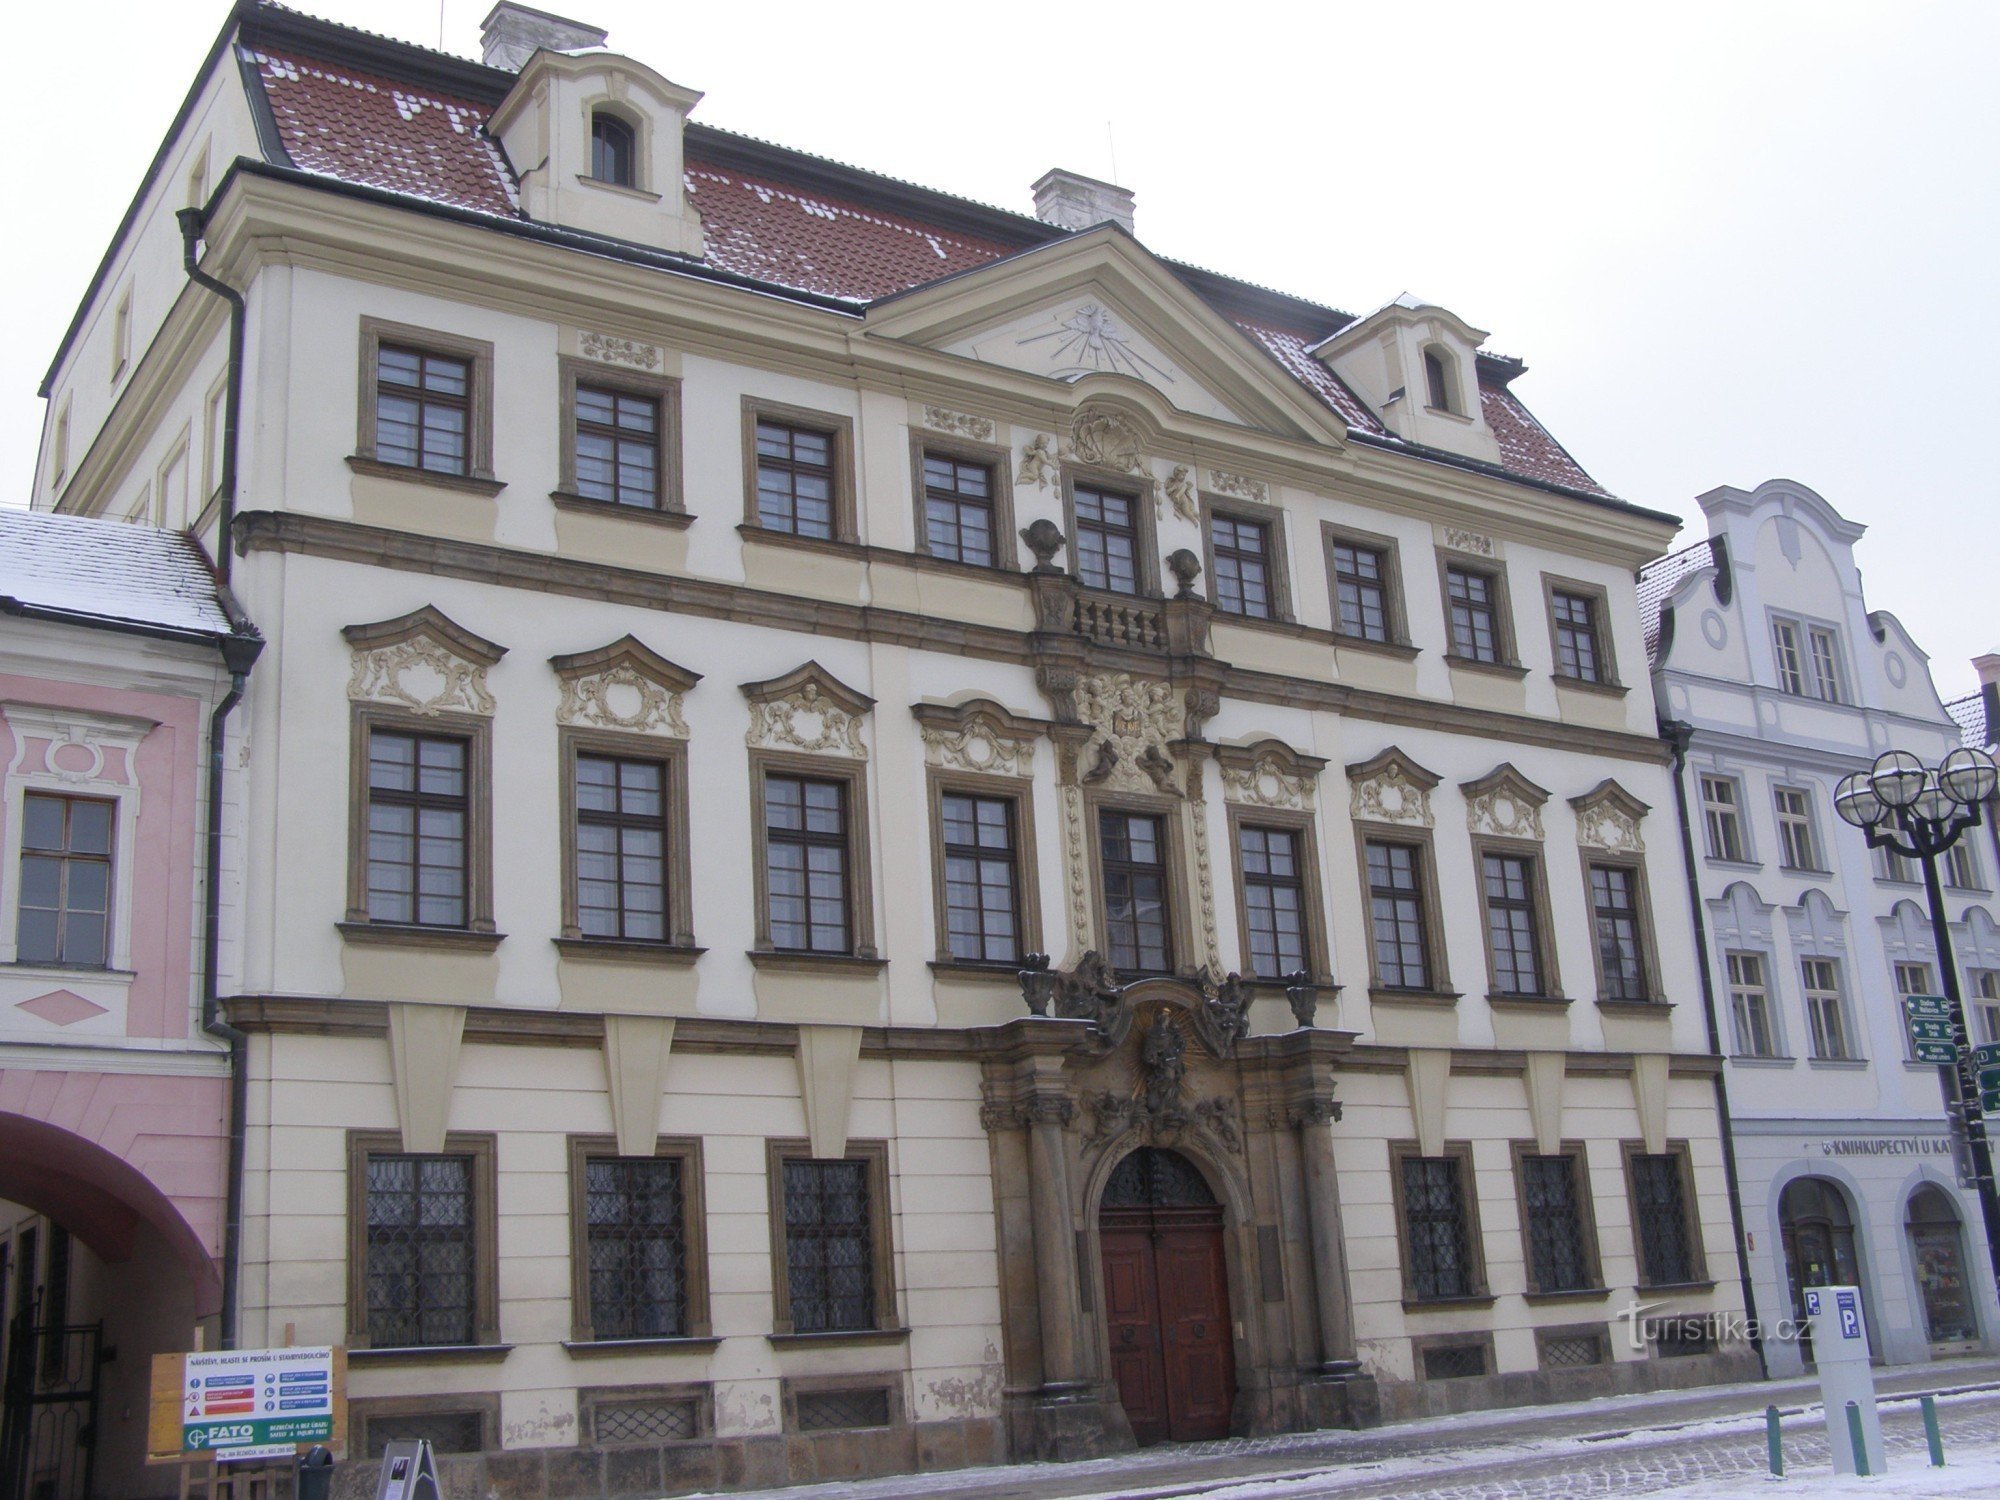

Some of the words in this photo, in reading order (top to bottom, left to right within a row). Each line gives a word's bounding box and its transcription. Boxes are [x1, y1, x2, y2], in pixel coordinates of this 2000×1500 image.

[1833, 1136, 1919, 1155] KNIHKUPECTVÍ
[1921, 1139, 1930, 1154] U
[1807, 1293, 1818, 1309] P
[1842, 1309, 1855, 1335] P
[242, 1355, 249, 1363] SE
[208, 1424, 254, 1439] FATO
